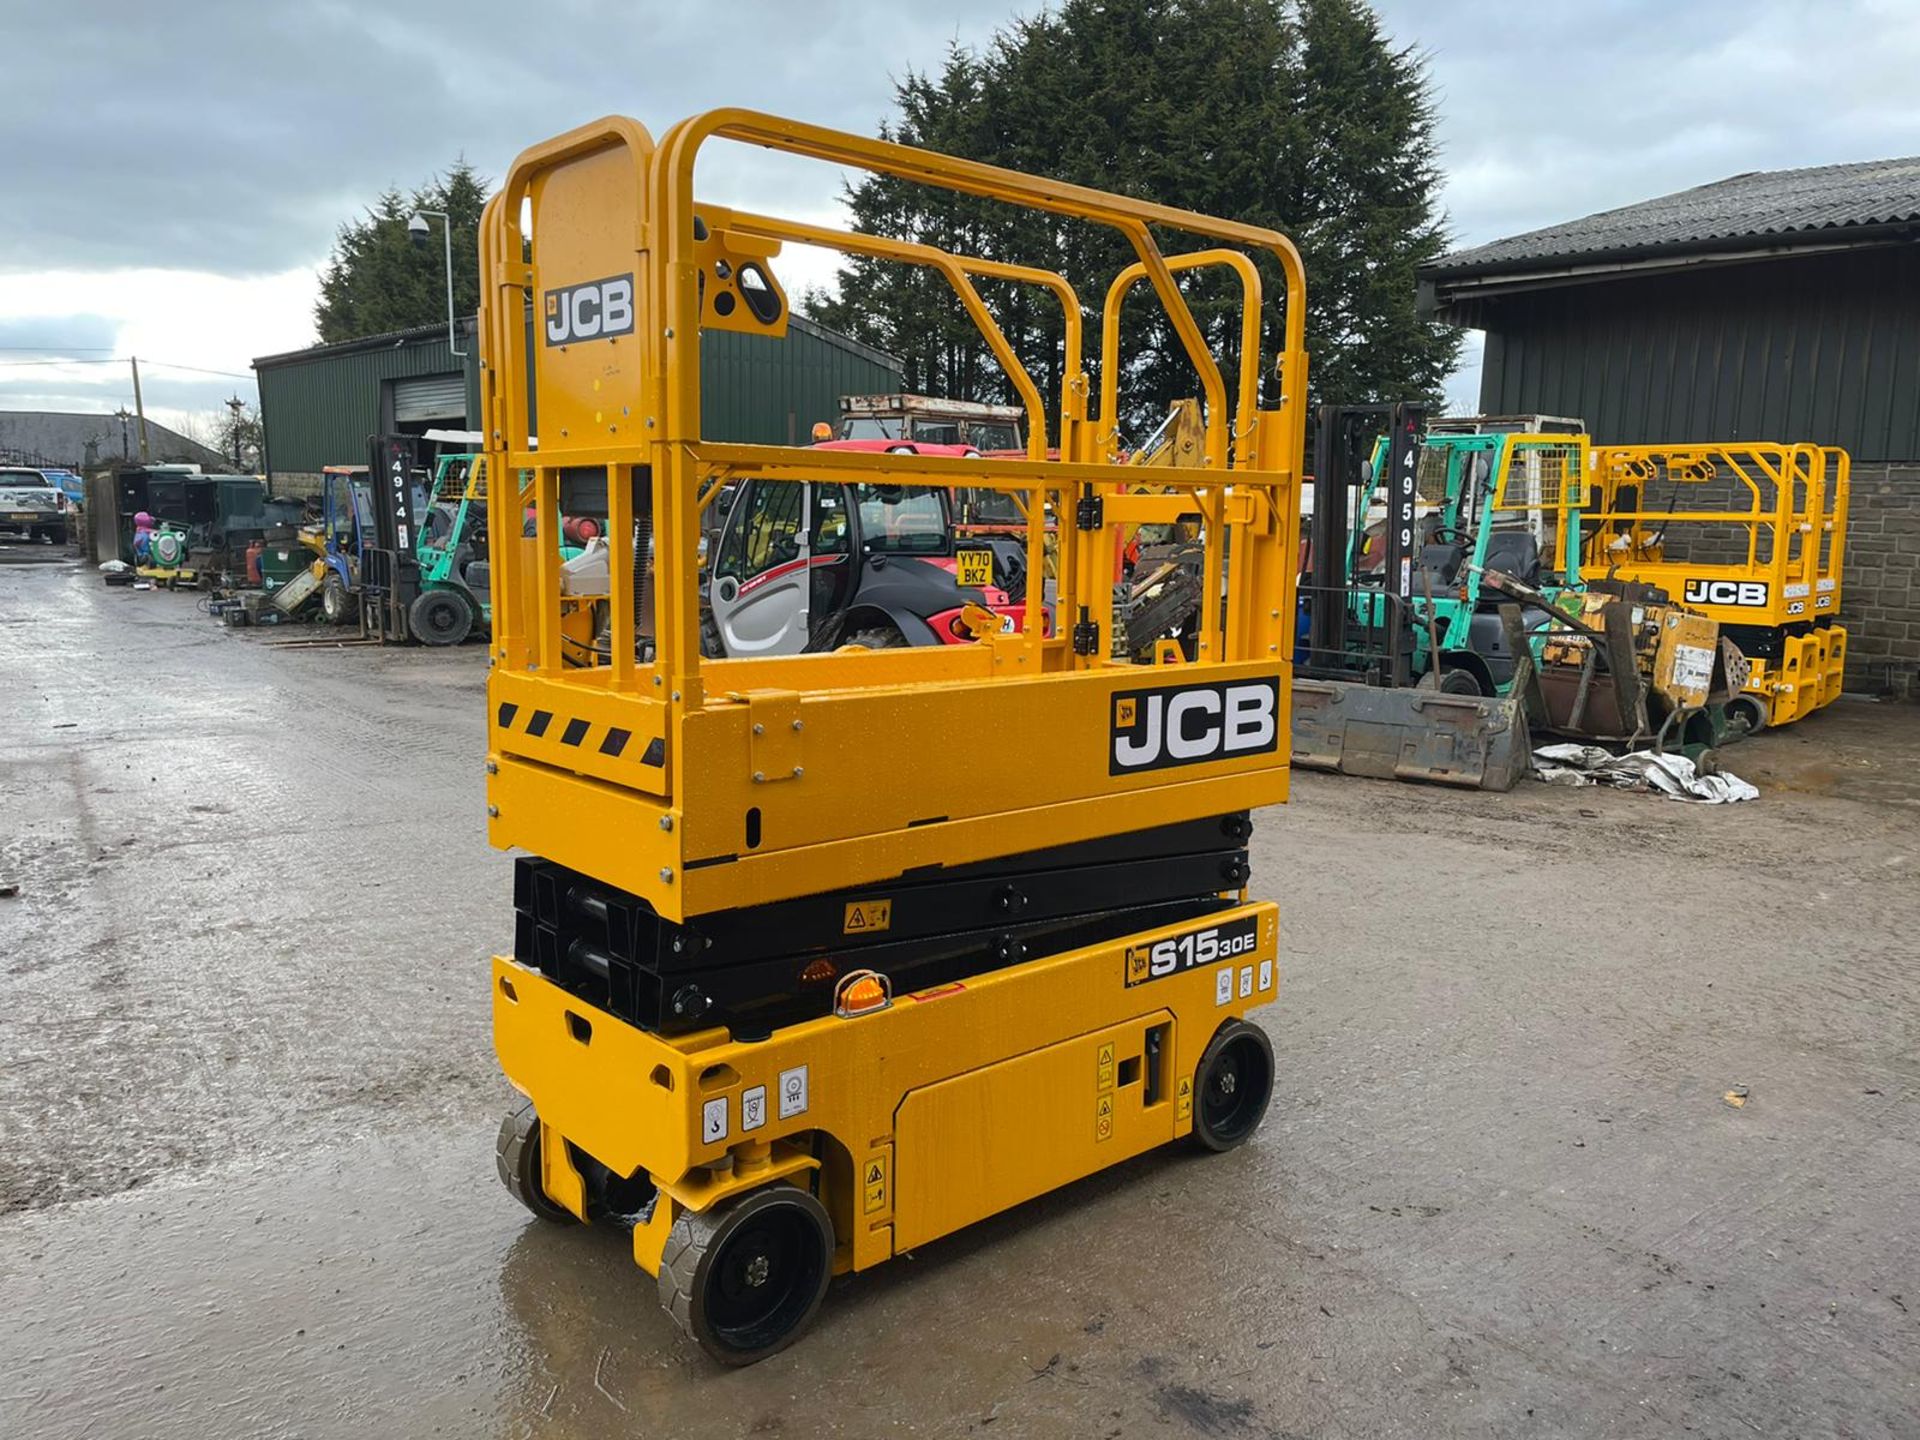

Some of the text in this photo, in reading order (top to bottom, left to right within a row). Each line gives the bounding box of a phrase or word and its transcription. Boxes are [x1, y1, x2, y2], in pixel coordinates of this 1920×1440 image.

[547, 279, 633, 342] JCB
[392, 460, 407, 518] 4914
[1400, 450, 1414, 547] 4959
[960, 552, 990, 566] YY70
[964, 568, 986, 582] BKZ
[1685, 581, 1767, 606] JCB
[1815, 596, 1831, 608] JCB
[1787, 601, 1804, 614] JCB
[1115, 684, 1274, 767] JCB
